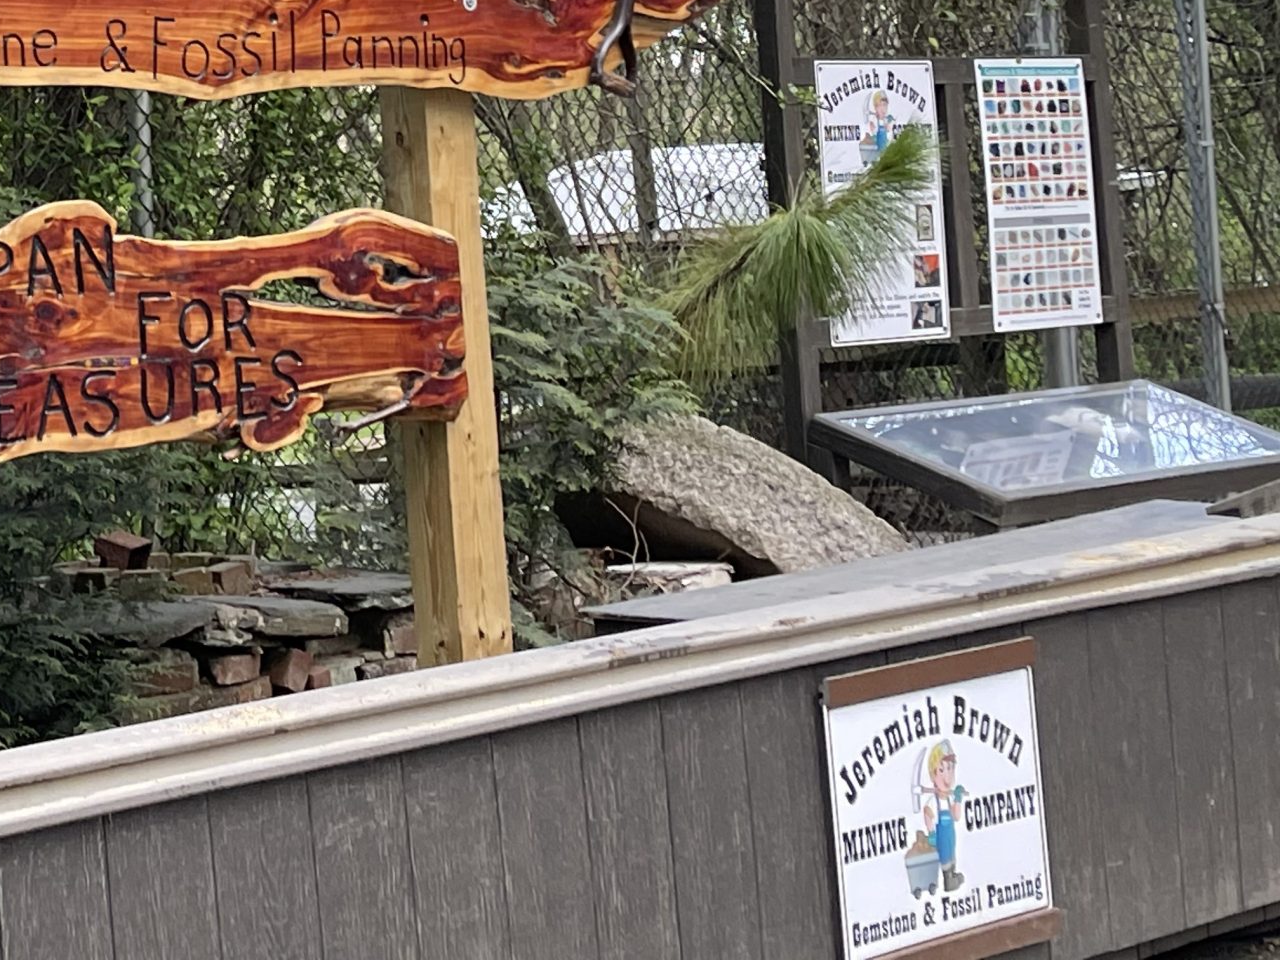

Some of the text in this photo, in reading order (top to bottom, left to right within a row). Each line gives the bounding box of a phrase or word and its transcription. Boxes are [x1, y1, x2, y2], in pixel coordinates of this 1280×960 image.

[99, 18, 136, 74] &
[151, 10, 296, 82] Fossil
[320, 10, 467, 85] Panning
[822, 68, 927, 113] Jeremiah Brown
[823, 124, 861, 142] MINING
[137, 291, 257, 359] FOR
[839, 695, 1024, 805] Jeremiah Brown
[842, 784, 1036, 865] MINING COMPANY
[851, 872, 1044, 948] Gemstone & Fossil Panning
